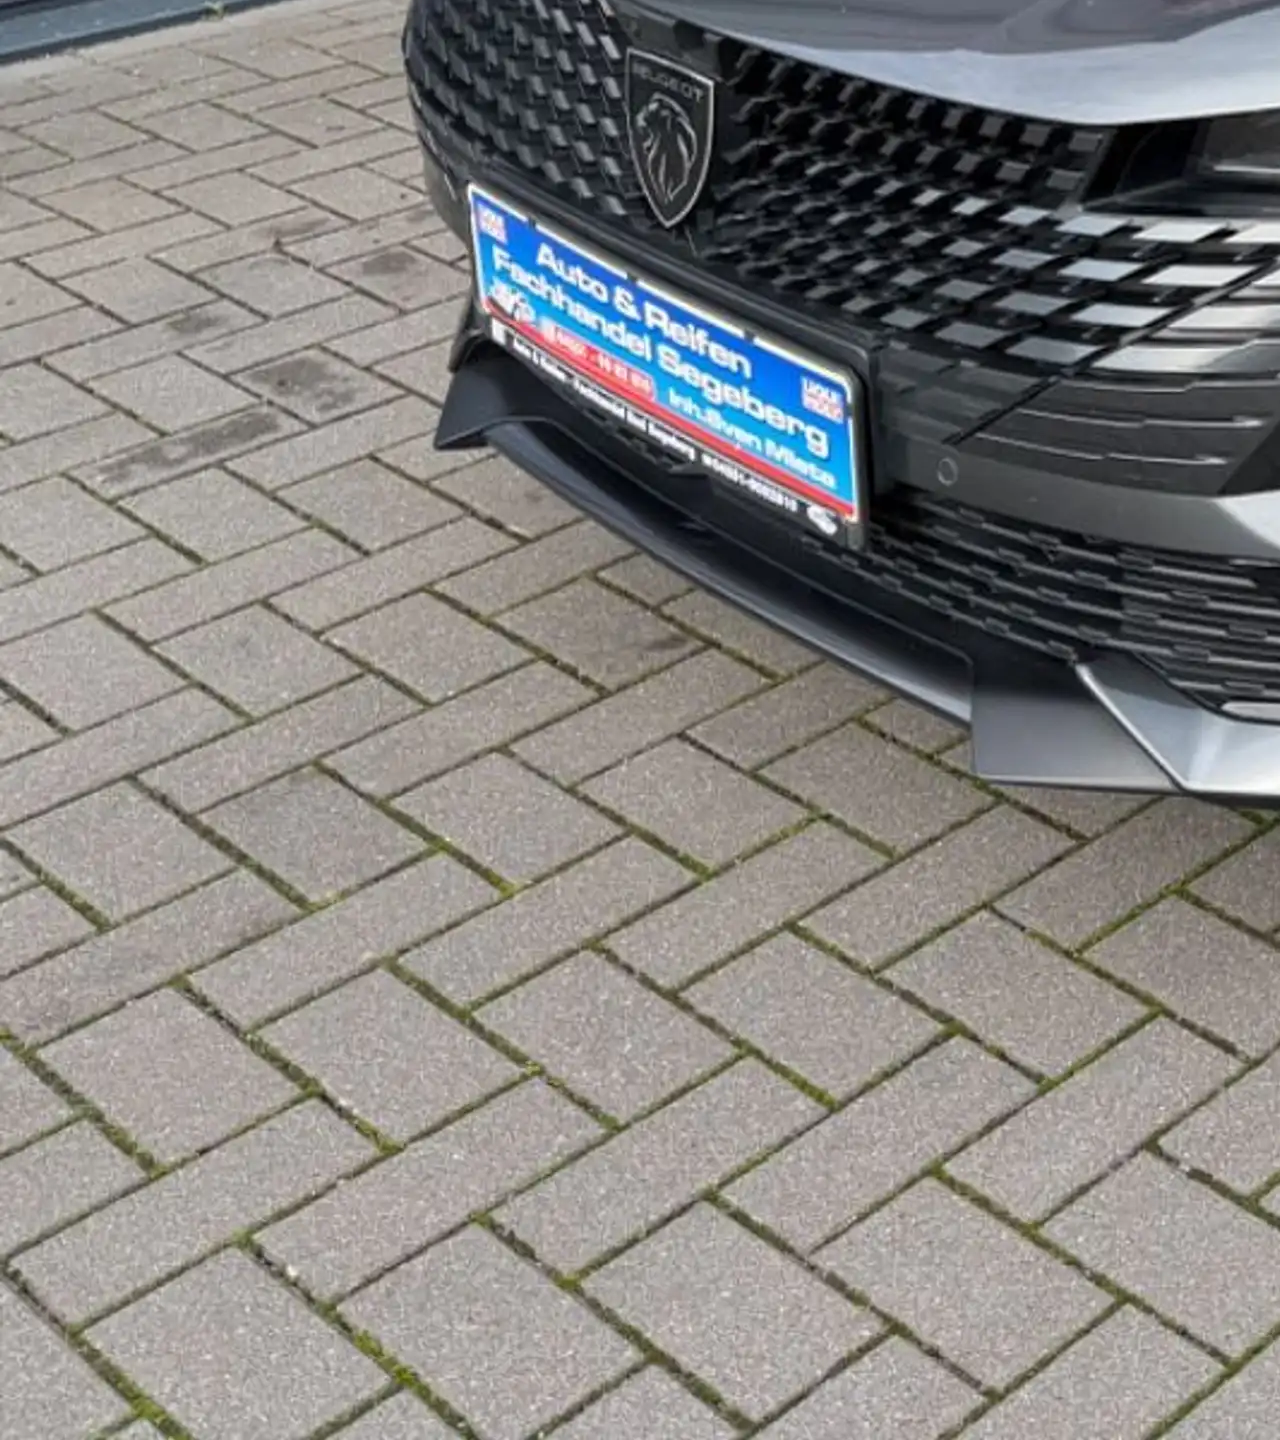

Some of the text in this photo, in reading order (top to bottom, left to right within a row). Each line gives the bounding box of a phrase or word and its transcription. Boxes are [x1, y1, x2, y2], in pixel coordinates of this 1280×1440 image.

[492, 244, 653, 362] Fachhandel
[657, 343, 830, 460] Segeberg
[536, 243, 609, 303] Auto
[613, 286, 641, 321] &
[644, 301, 752, 379] Reifen
